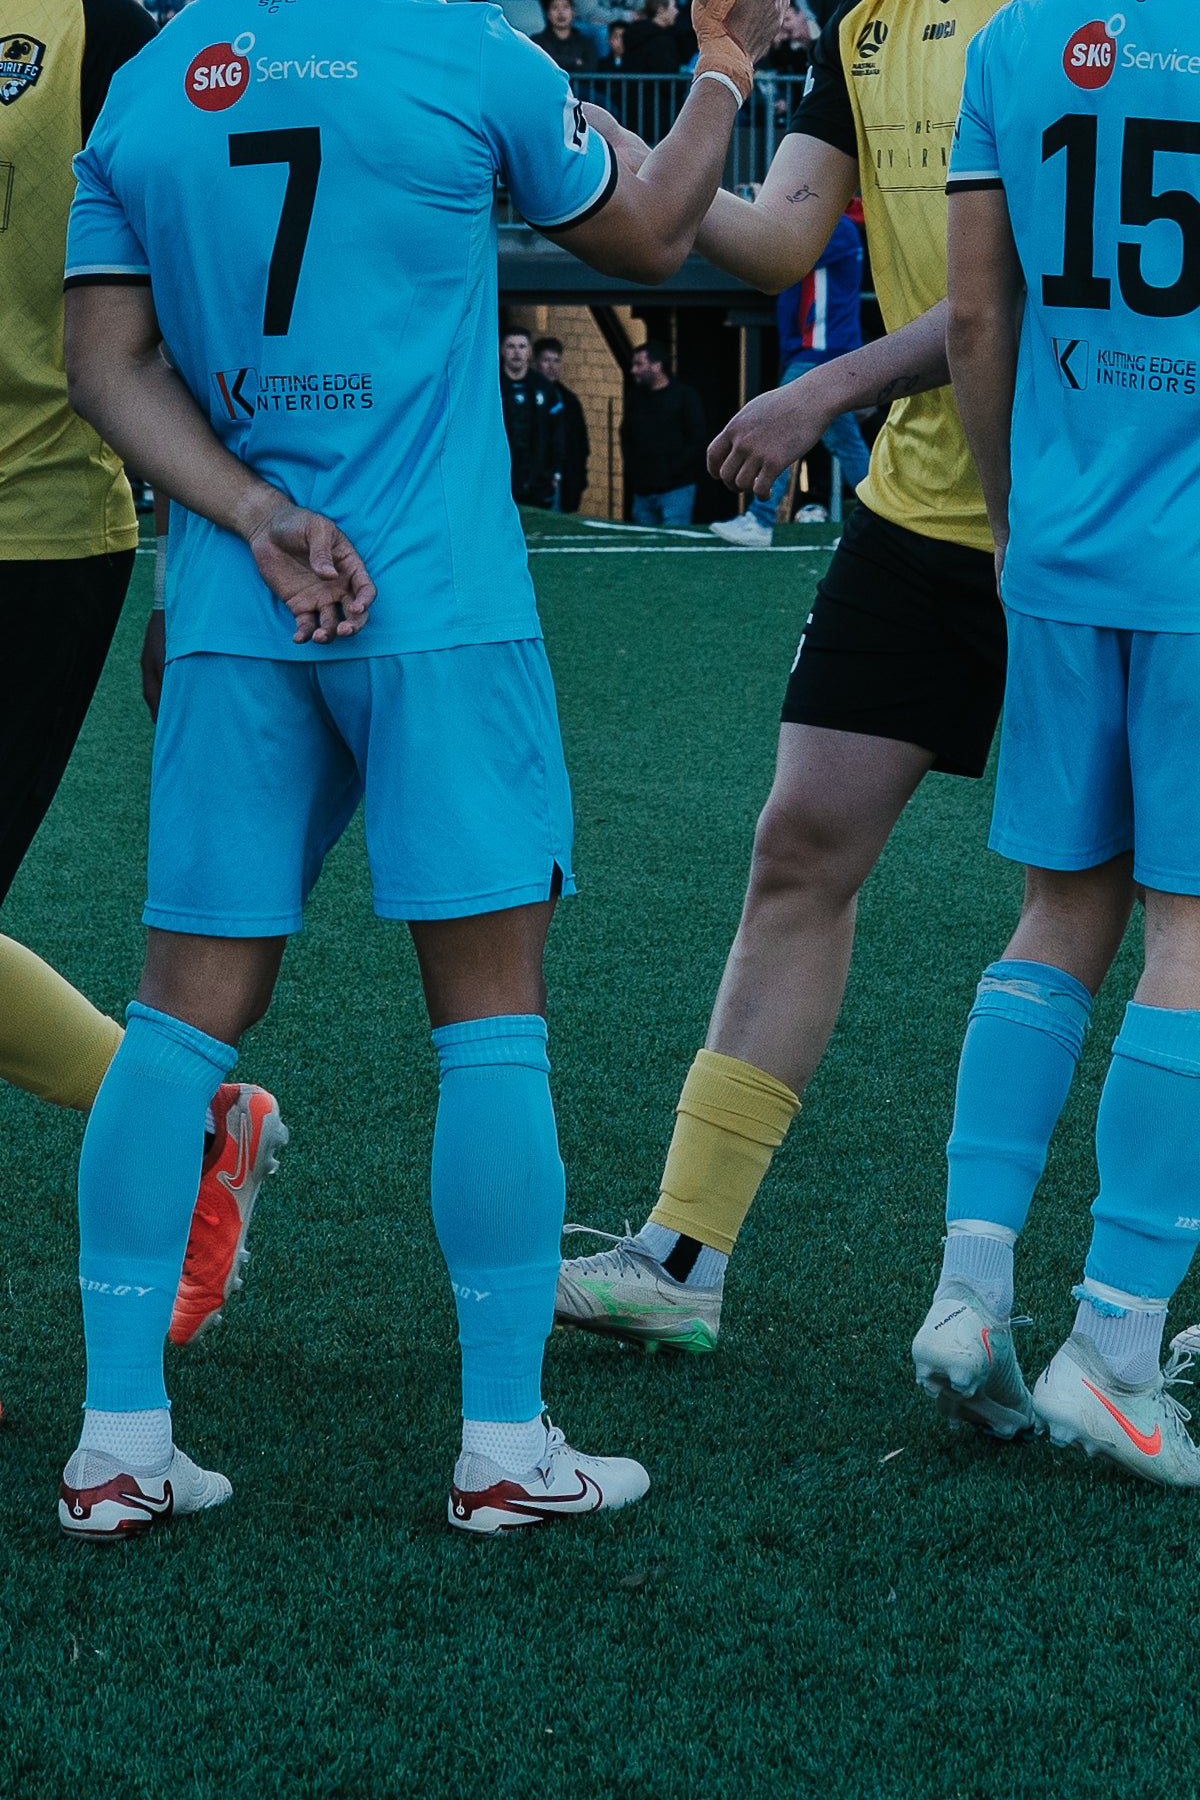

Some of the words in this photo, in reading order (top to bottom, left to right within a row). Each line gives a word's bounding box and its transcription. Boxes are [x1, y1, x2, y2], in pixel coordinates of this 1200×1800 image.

[1071, 42, 1112, 68] SKG
[24, 64, 39, 77] FC
[193, 61, 242, 91] SKG
[256, 54, 359, 83] Services
[229, 127, 322, 336] 7
[1150, 356, 1197, 377] EDGE
[323, 372, 373, 392] EDGE
[1096, 367, 1197, 395] INTERIORS
[256, 392, 374, 412] NTERIORS
